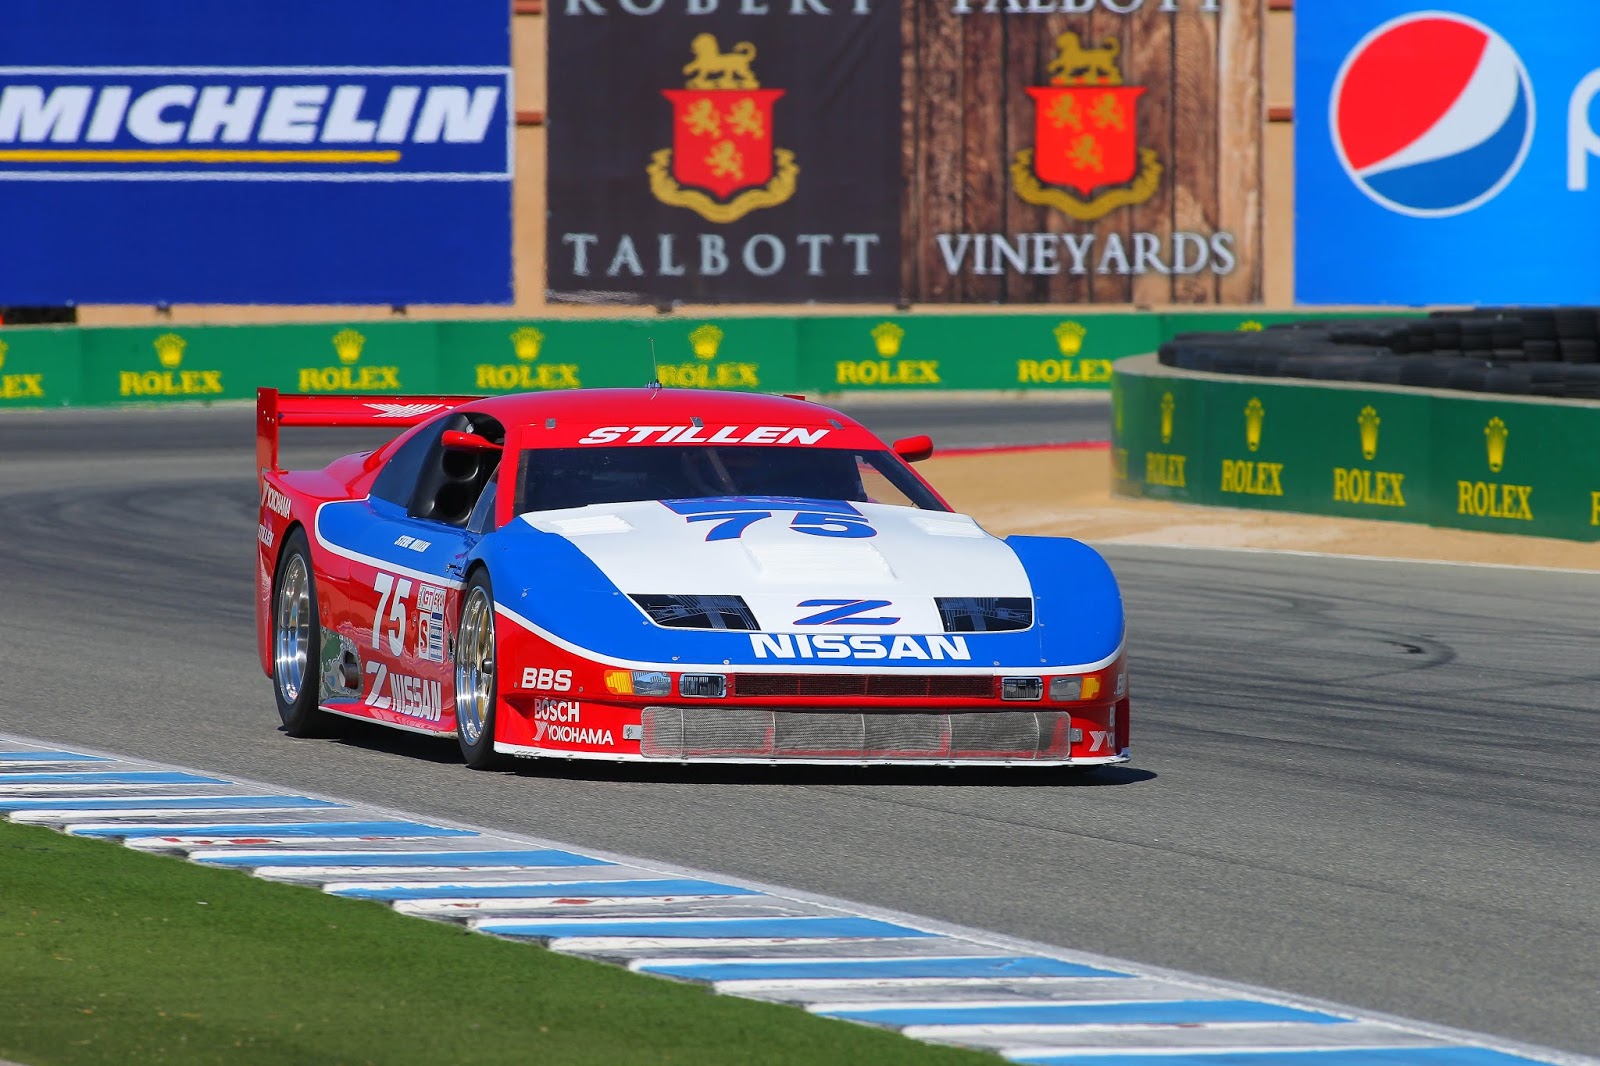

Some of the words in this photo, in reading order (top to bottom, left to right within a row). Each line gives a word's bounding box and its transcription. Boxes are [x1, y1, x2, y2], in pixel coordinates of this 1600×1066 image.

[0, 85, 499, 143] MICHELIN
[563, 232, 880, 276] TALBOTT
[937, 231, 1236, 275] VINEYARDS
[120, 371, 222, 395] ROLEX
[299, 367, 400, 391] ROLEX
[476, 364, 579, 389] ROLEX
[656, 362, 758, 387] ROLEX
[836, 360, 940, 385] ROLEX
[578, 425, 830, 446] STILLEN
[1147, 453, 1186, 487] ROLEX
[1221, 459, 1283, 496] ROLEX
[1333, 467, 1406, 507] ROLEX
[1457, 480, 1533, 521] ROLEX
[686, 511, 877, 542] 75
[373, 573, 412, 656] 75
[792, 599, 902, 626] Z
[750, 633, 971, 661] NISSAN
[364, 660, 392, 710] Z
[389, 672, 442, 722] NISSAN
[521, 667, 573, 692] BBS
[534, 698, 580, 723] BOSCH
[546, 724, 615, 746] YOKOHAMA
